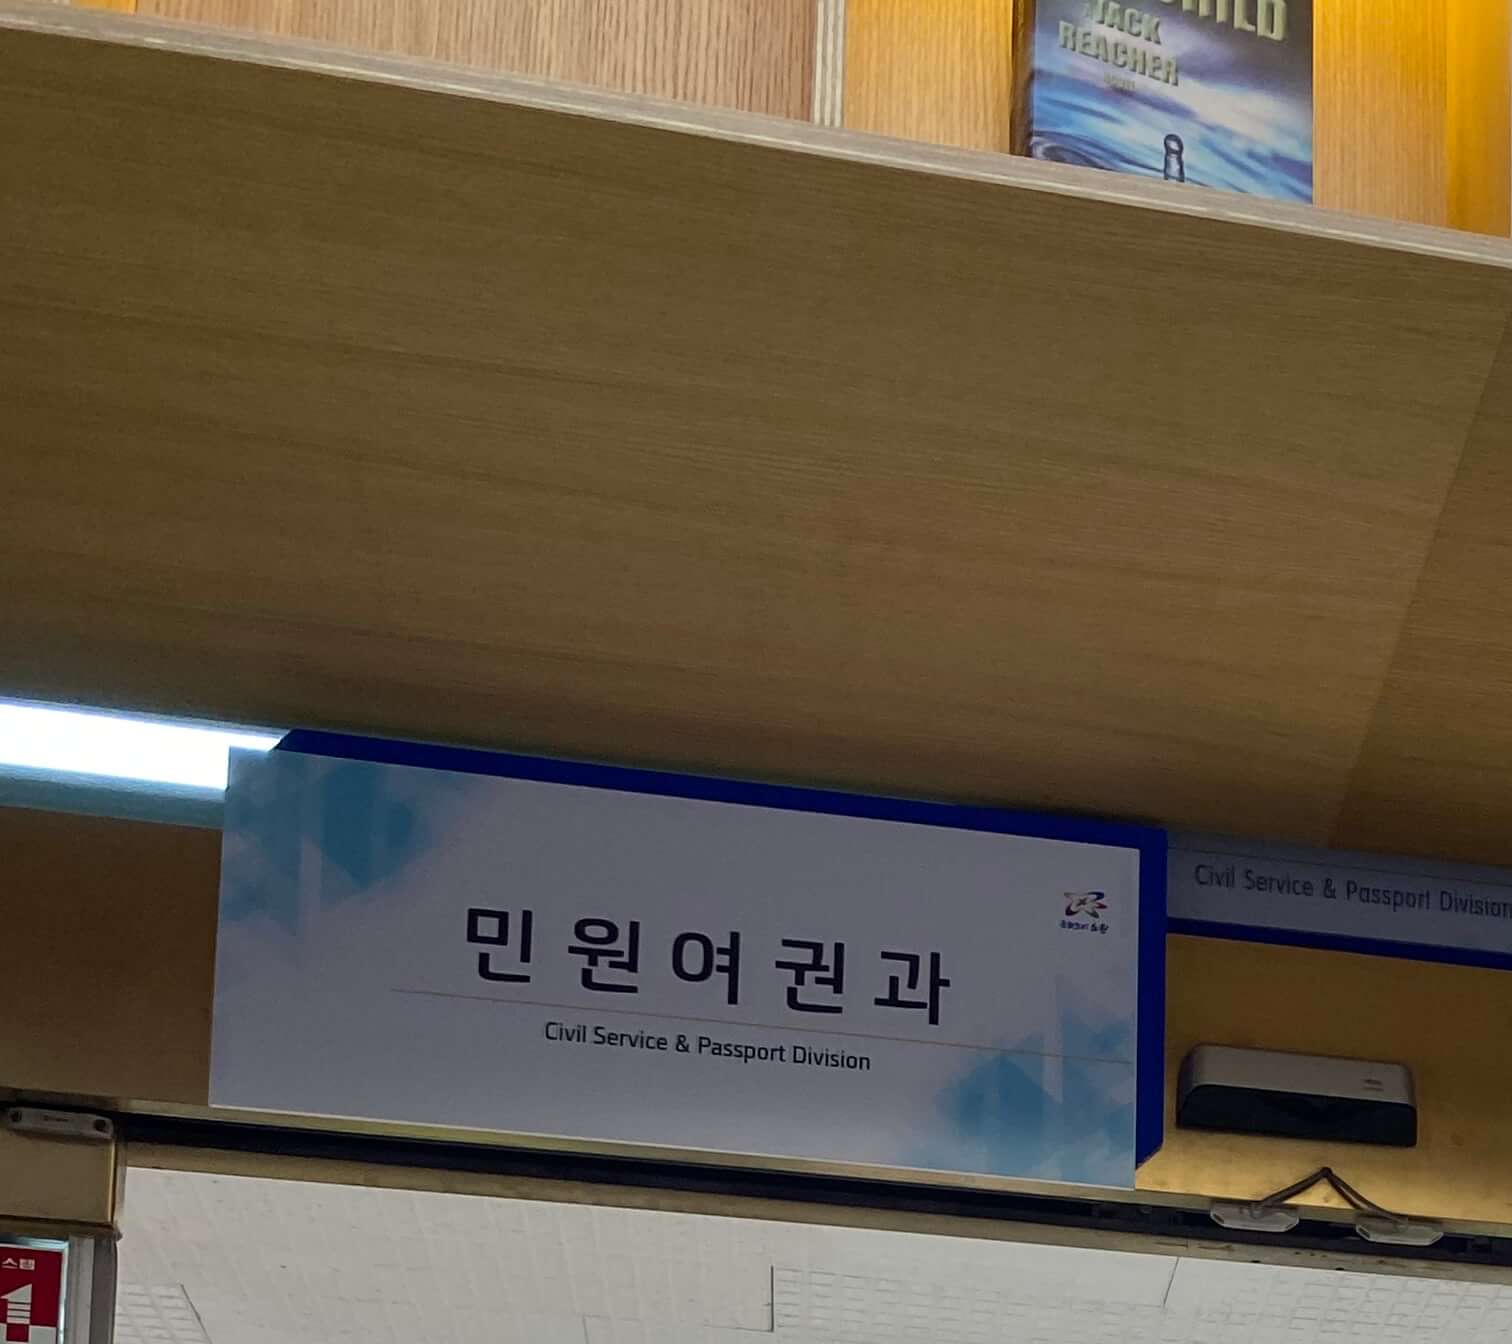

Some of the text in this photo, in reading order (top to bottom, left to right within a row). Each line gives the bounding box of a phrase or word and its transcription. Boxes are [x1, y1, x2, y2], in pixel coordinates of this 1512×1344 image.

[1057, 21, 1178, 86] REACHER
[1194, 864, 1236, 889] Civil
[1244, 869, 1314, 898] Service
[1323, 878, 1337, 899] &
[1346, 881, 1432, 913] Passport
[466, 907, 951, 1026] 민원여권과
[544, 1021, 871, 1072] Civil Service & Passport Division
